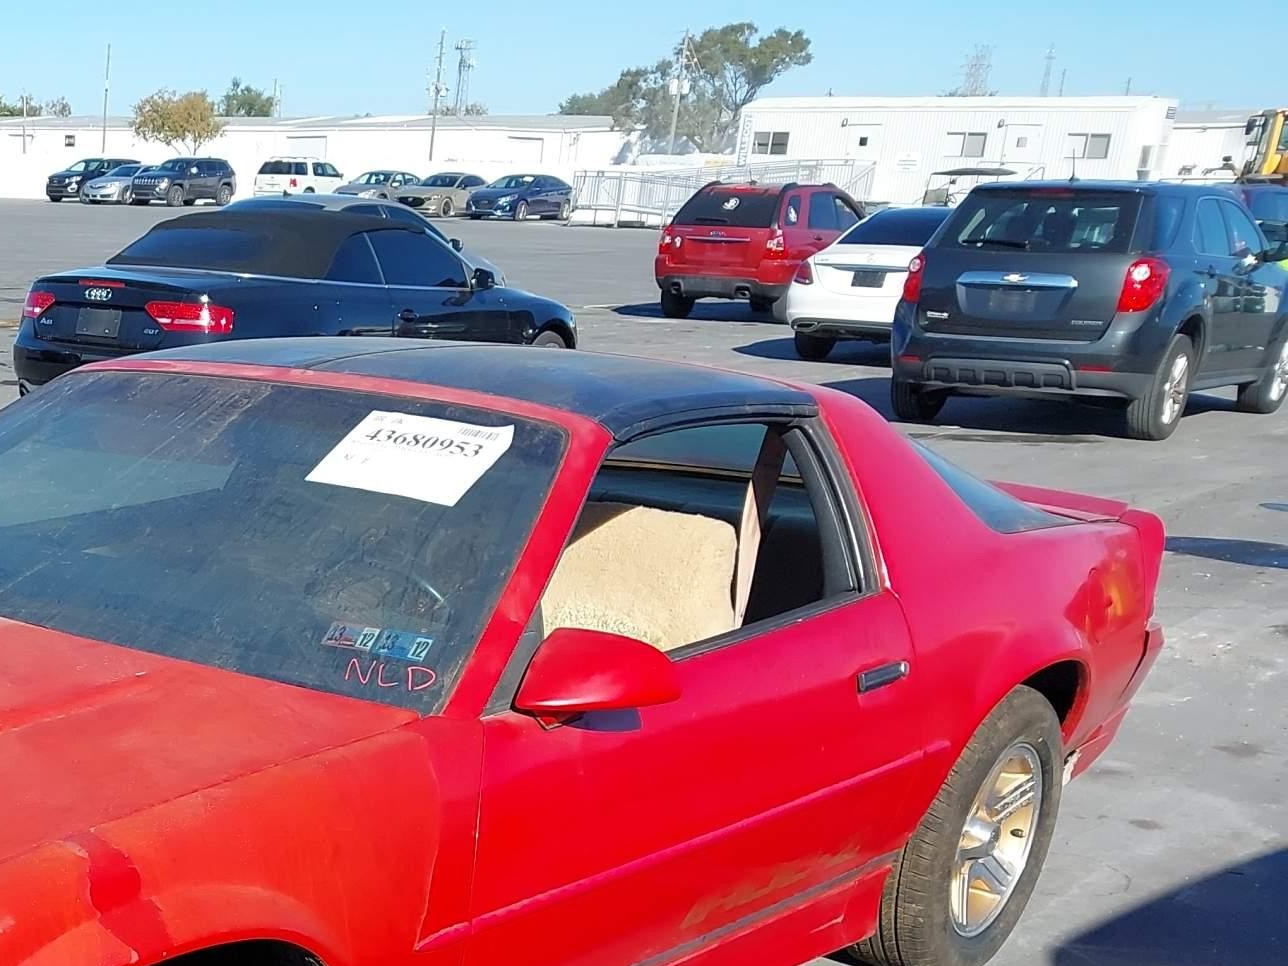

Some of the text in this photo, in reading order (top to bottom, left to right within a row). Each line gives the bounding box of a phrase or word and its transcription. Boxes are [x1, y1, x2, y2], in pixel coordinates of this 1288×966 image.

[365, 427, 485, 458] 43680953
[358, 631, 376, 648] 12
[411, 640, 429, 659] 12
[345, 658, 436, 692] NLD
